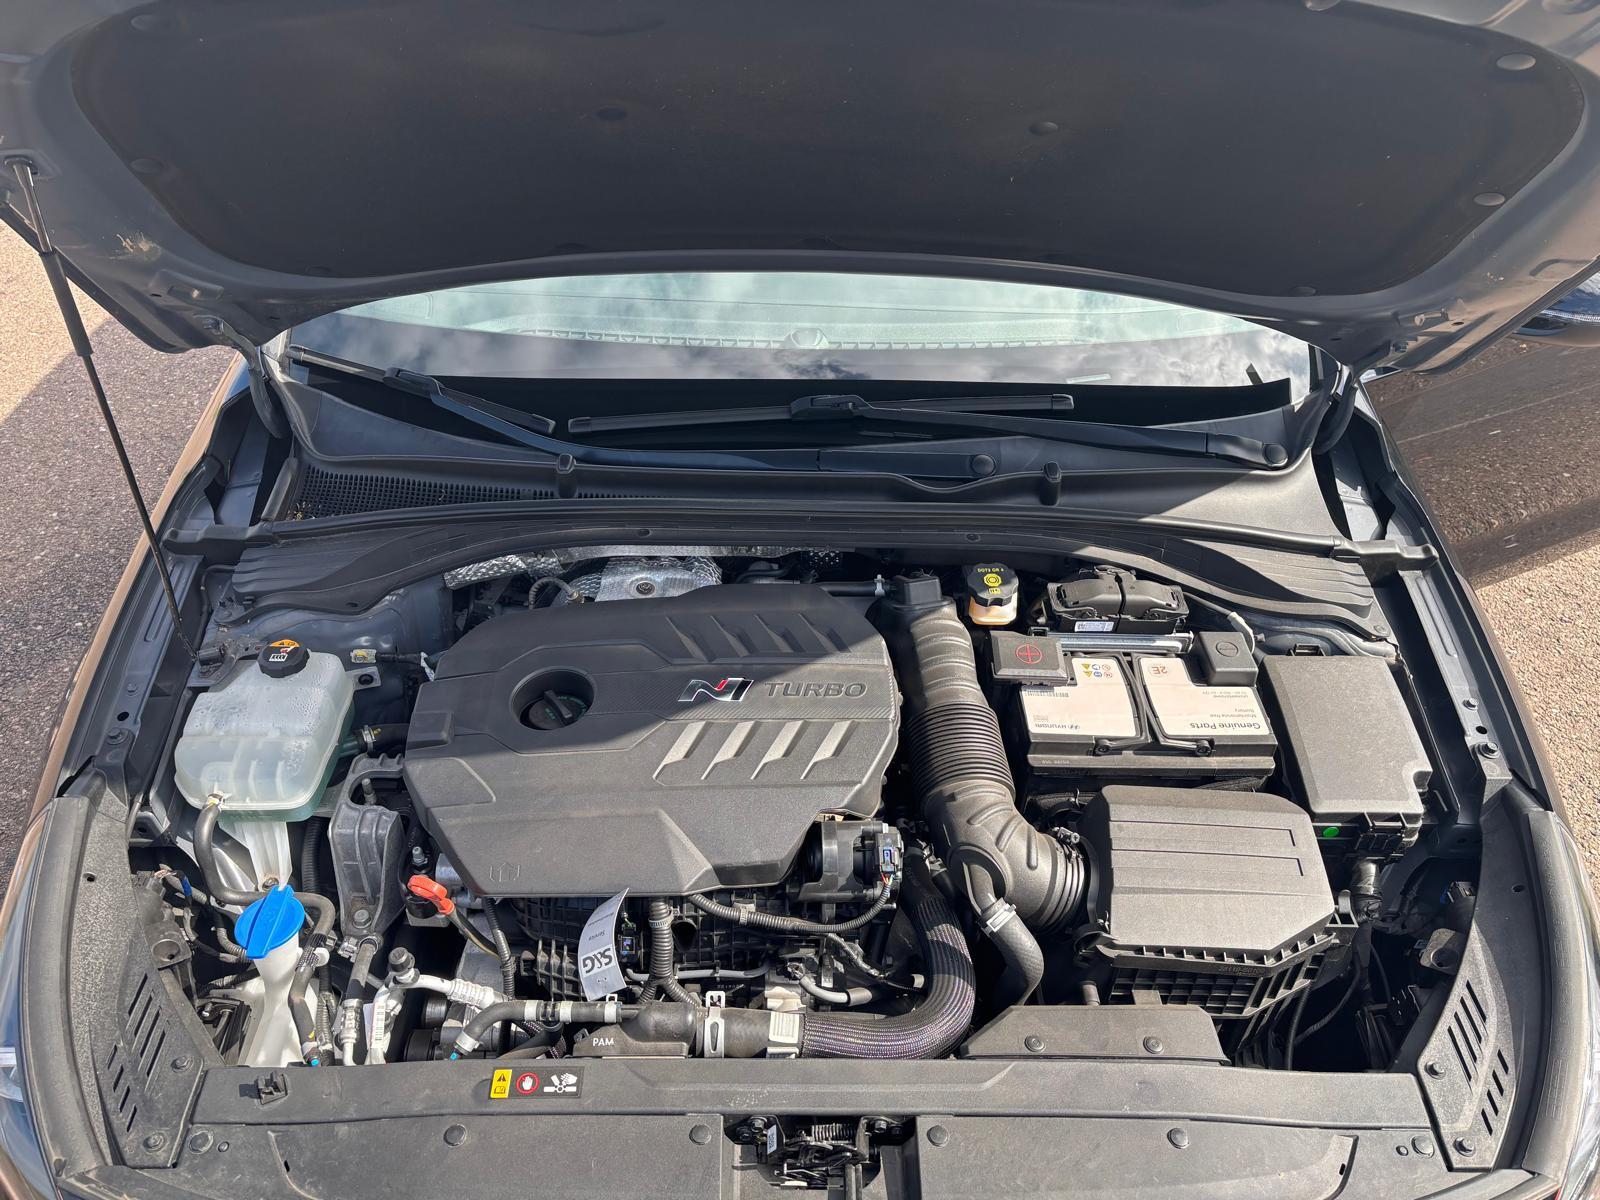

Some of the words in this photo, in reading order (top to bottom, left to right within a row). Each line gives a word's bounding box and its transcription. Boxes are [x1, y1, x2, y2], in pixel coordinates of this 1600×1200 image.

[1151, 666, 1168, 675] 2E
[764, 681, 868, 699] TURBO
[1189, 722, 1216, 730] Parts
[1218, 722, 1261, 731] Genuine
[582, 946, 613, 974] S&G
[592, 1037, 615, 1047] PAM
